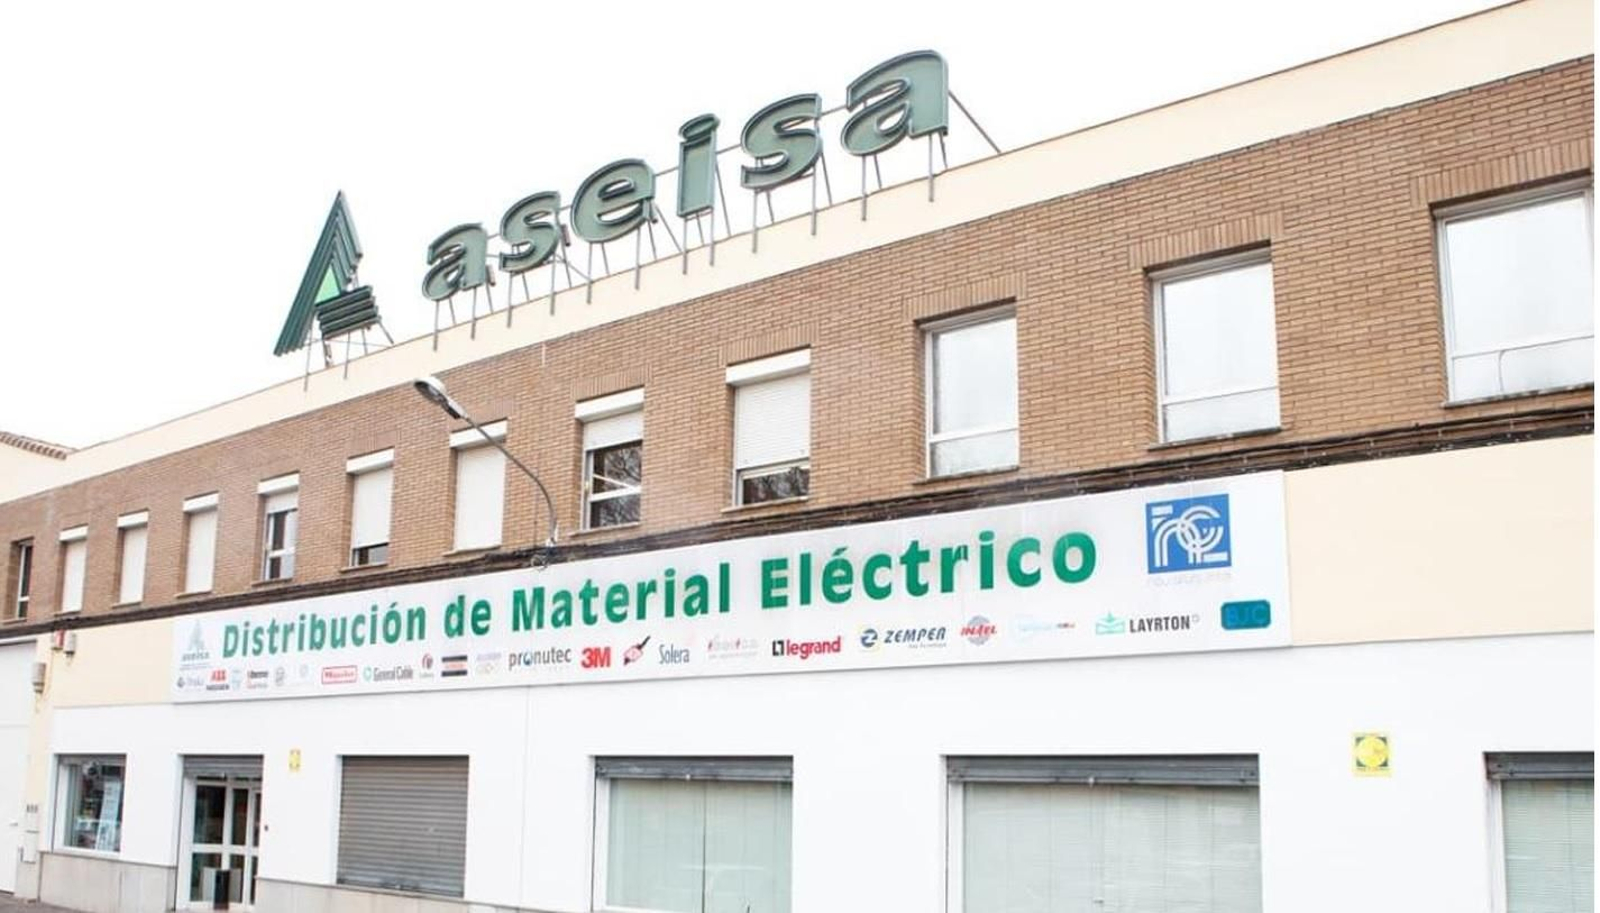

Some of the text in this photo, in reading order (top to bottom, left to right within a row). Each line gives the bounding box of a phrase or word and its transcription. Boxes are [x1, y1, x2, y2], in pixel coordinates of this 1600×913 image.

[421, 50, 949, 301] aseisa
[222, 531, 1096, 658] Distribución de Material Eléctrico
[508, 647, 572, 671] pronutec
[581, 646, 611, 670] 3M
[658, 643, 690, 665] Solera
[786, 636, 842, 661] legrand
